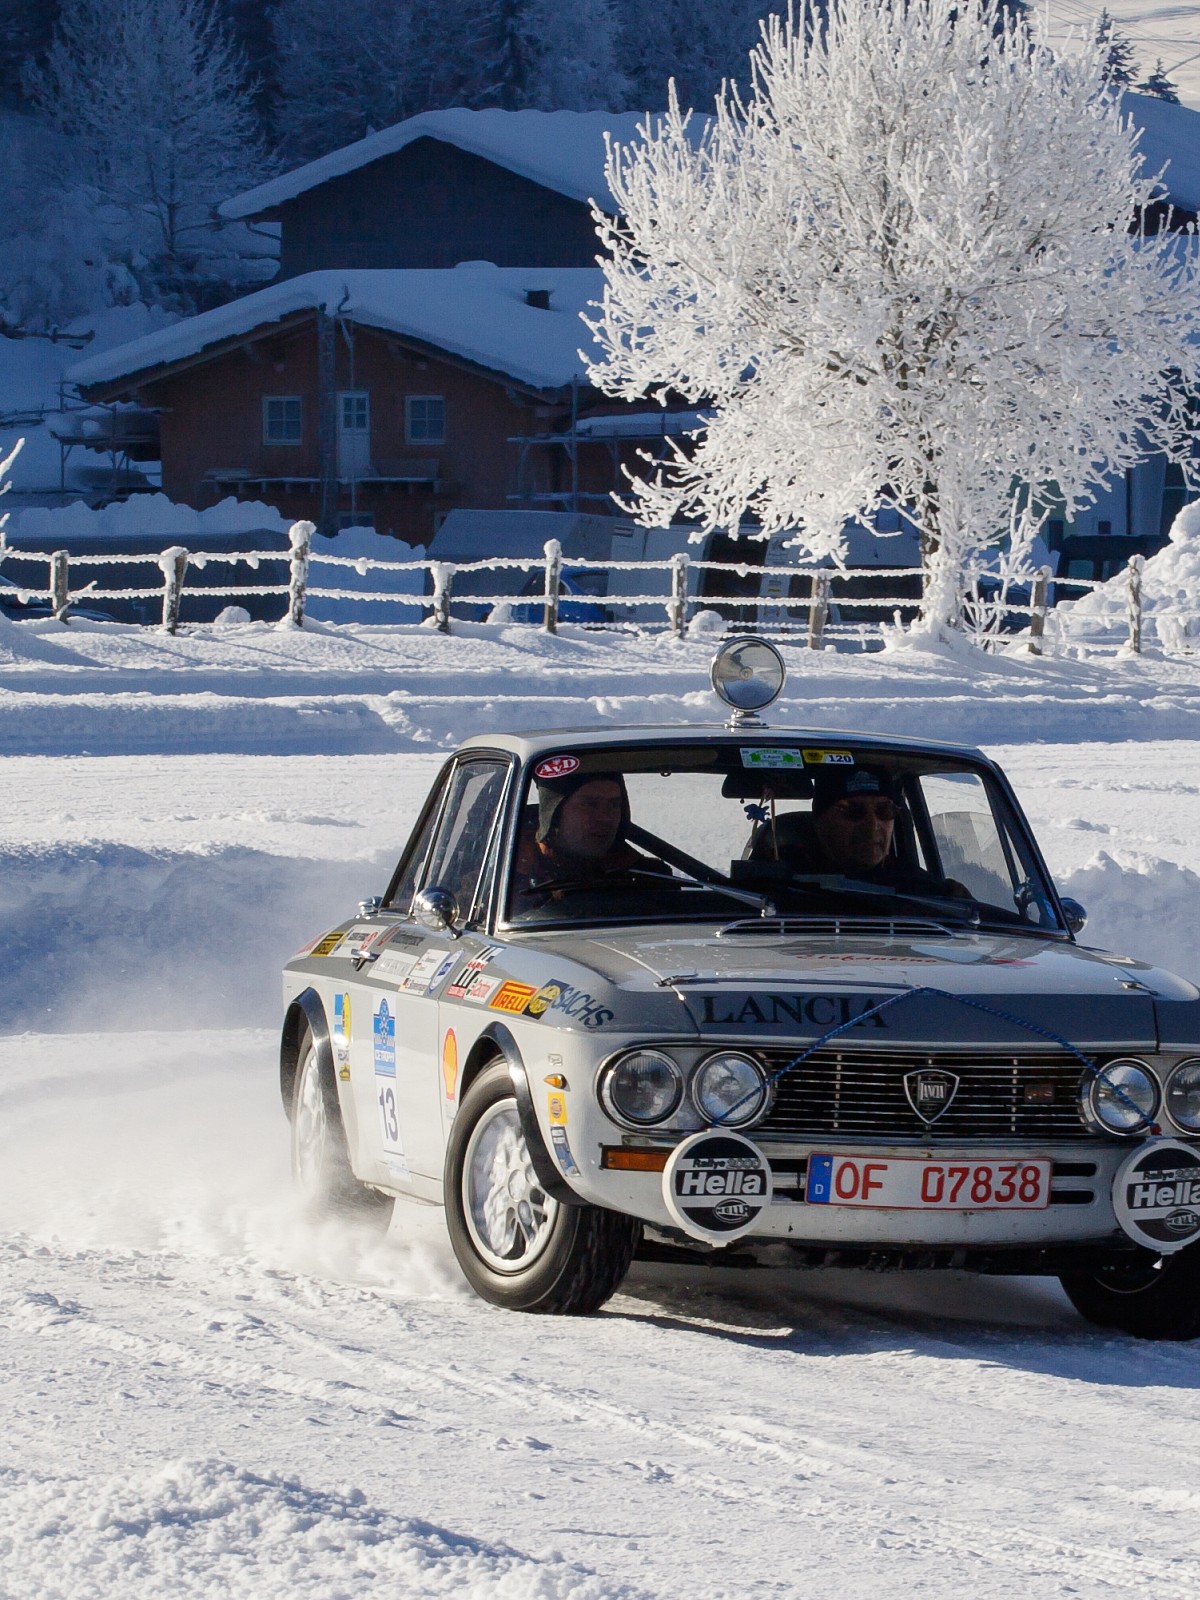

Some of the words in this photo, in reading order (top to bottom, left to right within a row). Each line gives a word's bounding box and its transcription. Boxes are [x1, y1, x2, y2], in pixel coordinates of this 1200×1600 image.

[829, 754, 852, 763] 120
[490, 981, 537, 1012] PIRELLI
[549, 986, 614, 1029] SACHS
[701, 995, 888, 1028] LANCIA
[920, 1082, 945, 1101] LANCIA
[379, 1087, 398, 1142] 13
[693, 1158, 726, 1170] Rallye
[681, 1171, 761, 1194] Hella
[814, 1184, 824, 1195] D
[835, 1161, 888, 1200] OF
[920, 1165, 1041, 1203] 07838
